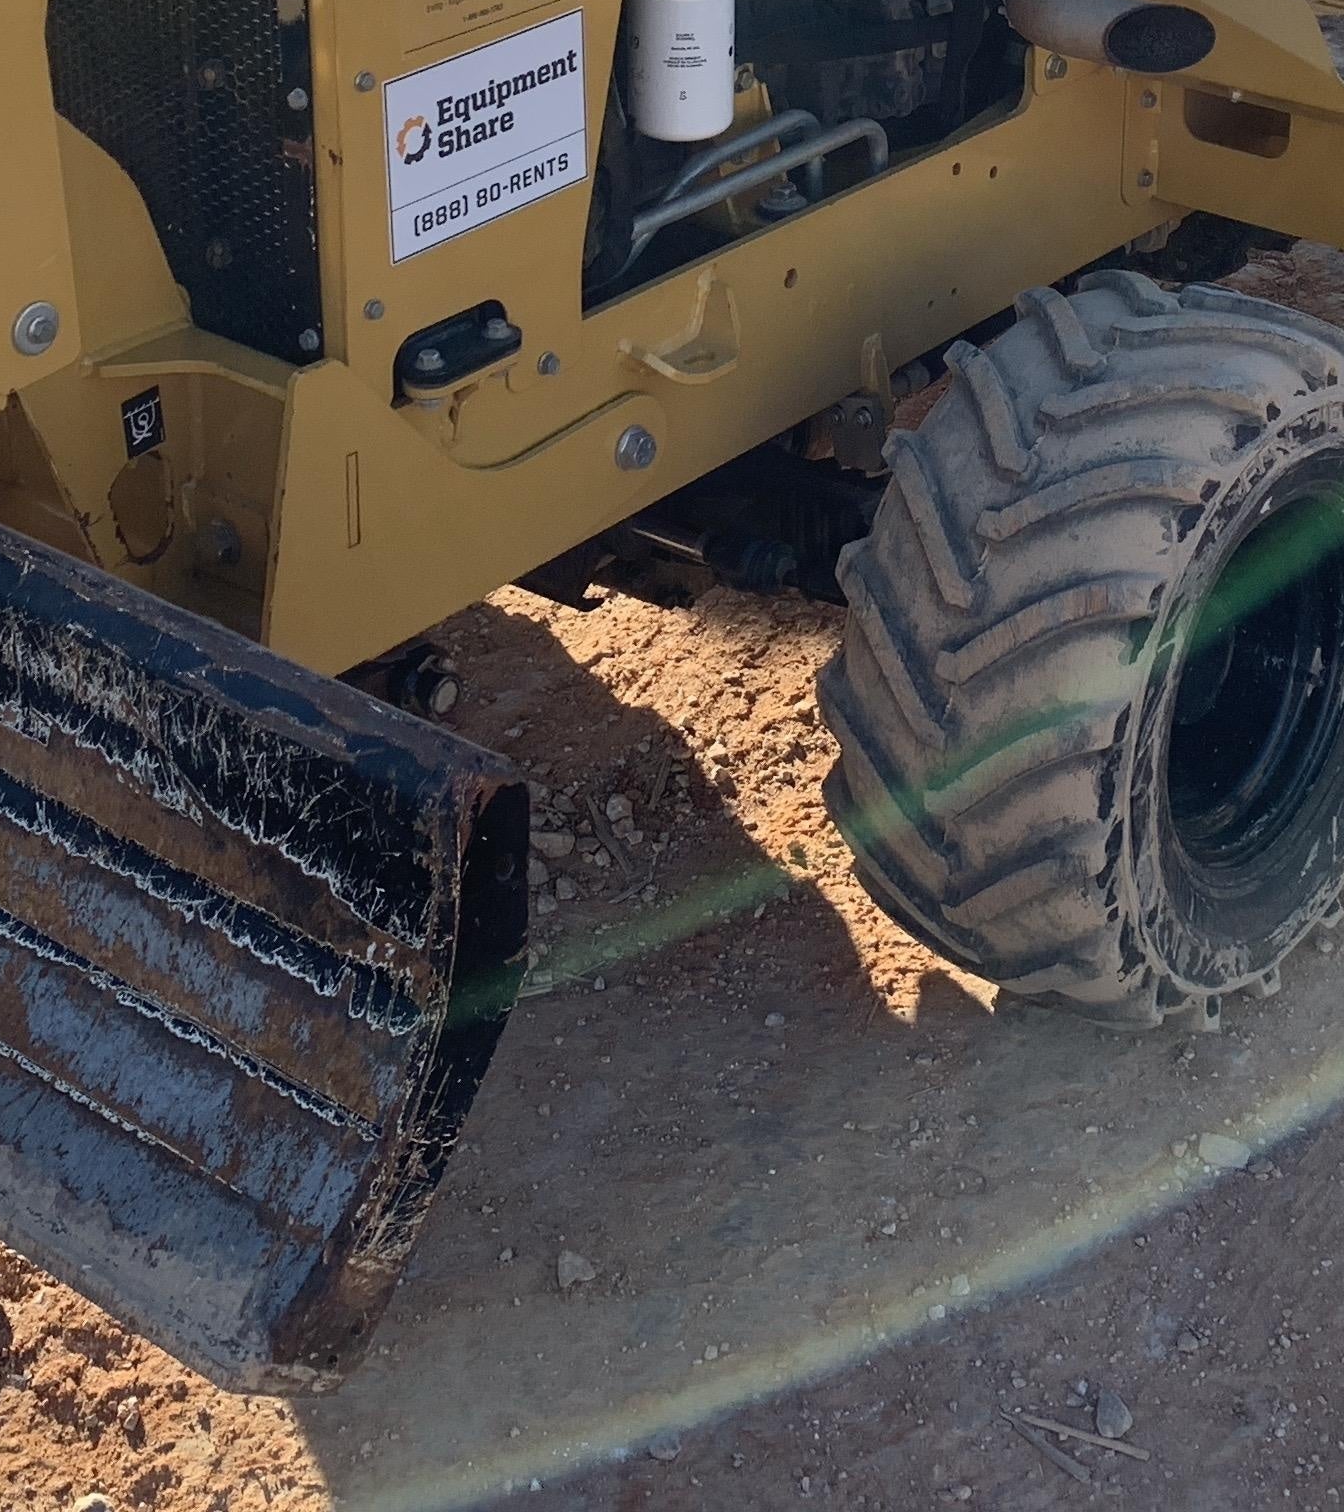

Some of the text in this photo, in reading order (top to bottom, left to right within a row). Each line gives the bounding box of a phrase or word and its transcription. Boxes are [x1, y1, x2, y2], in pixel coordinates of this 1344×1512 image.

[436, 49, 578, 127] Equipment
[437, 110, 515, 159] Share
[413, 152, 570, 237] (888) 80-RENTS
